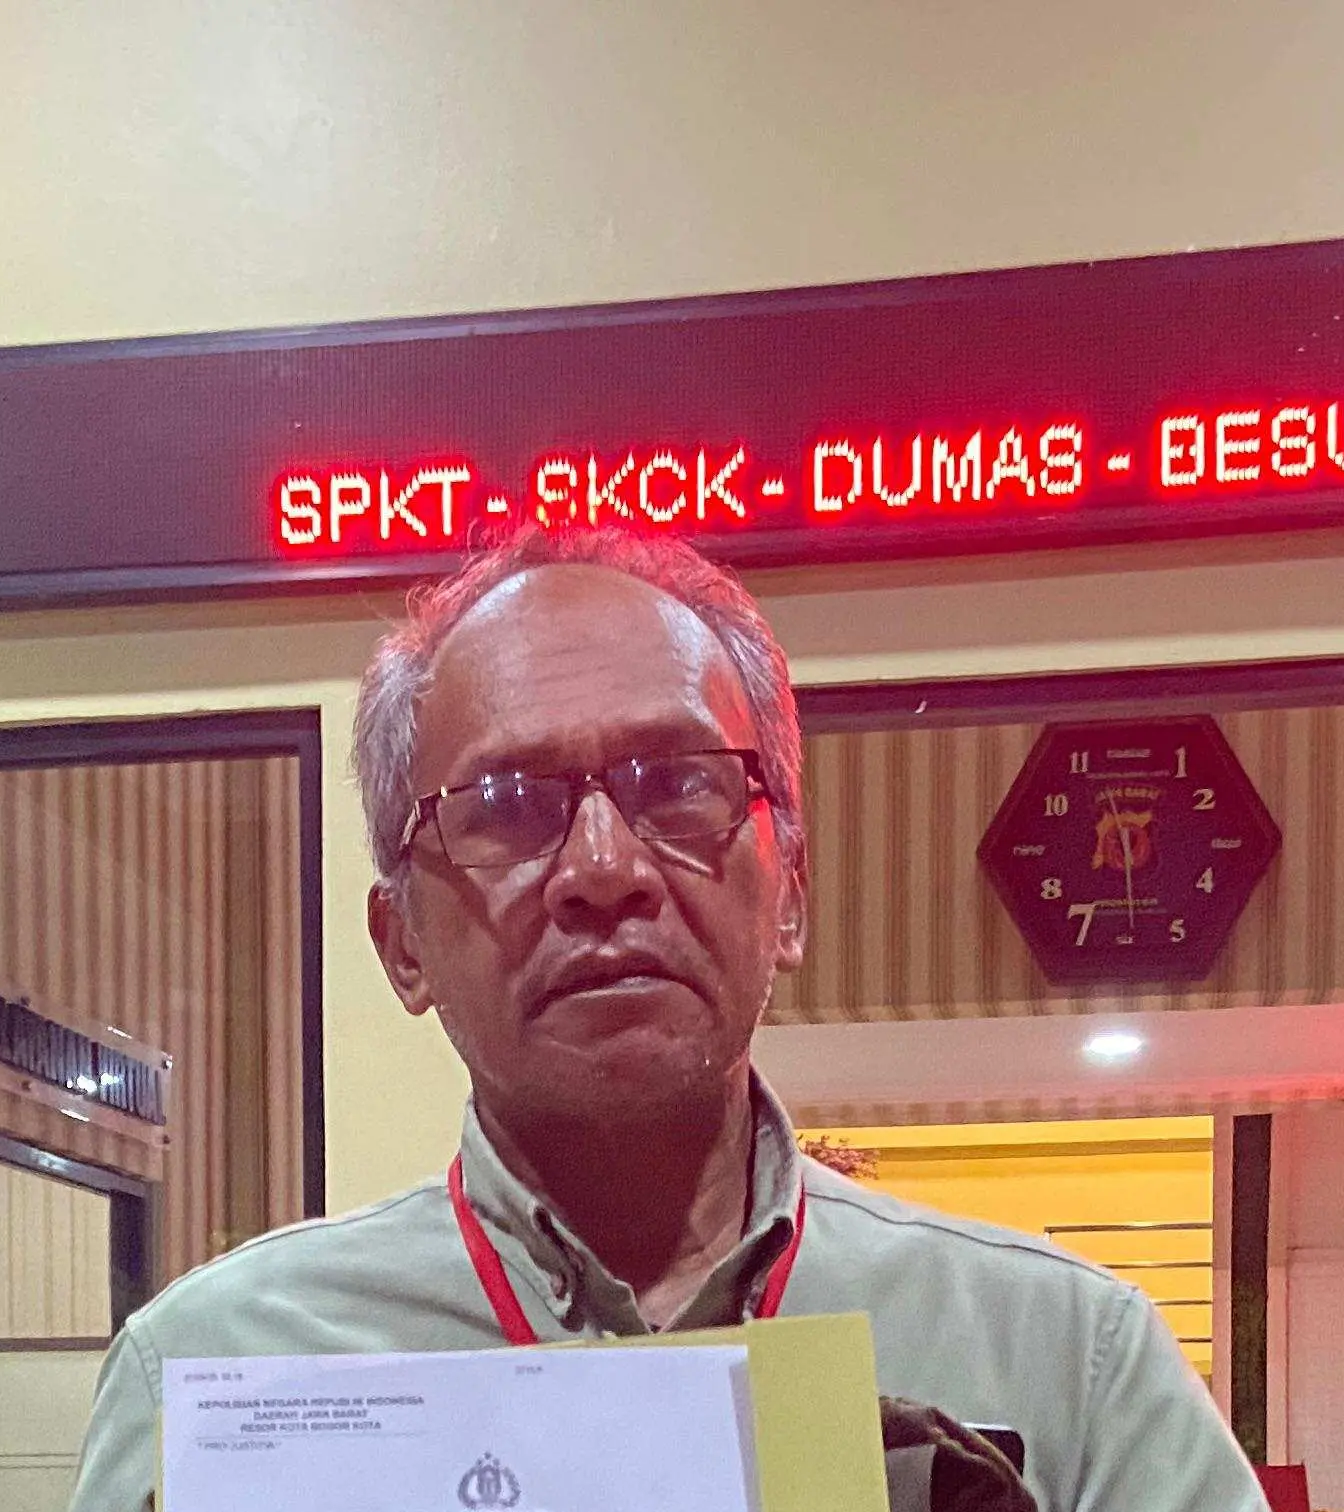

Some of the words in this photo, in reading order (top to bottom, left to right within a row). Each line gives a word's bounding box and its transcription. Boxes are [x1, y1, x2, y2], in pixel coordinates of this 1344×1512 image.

[281, 464, 471, 545] SPKT
[536, 449, 747, 528] SKCK
[812, 425, 1083, 512] DUMAS
[1069, 751, 1089, 774] 11
[1174, 745, 1188, 779] 1
[1043, 794, 1069, 817] 10
[1192, 788, 1216, 811] 2
[1040, 877, 1063, 900] 8
[1195, 867, 1214, 893] 4
[1067, 904, 1096, 946] 7
[1169, 918, 1187, 943] 5
